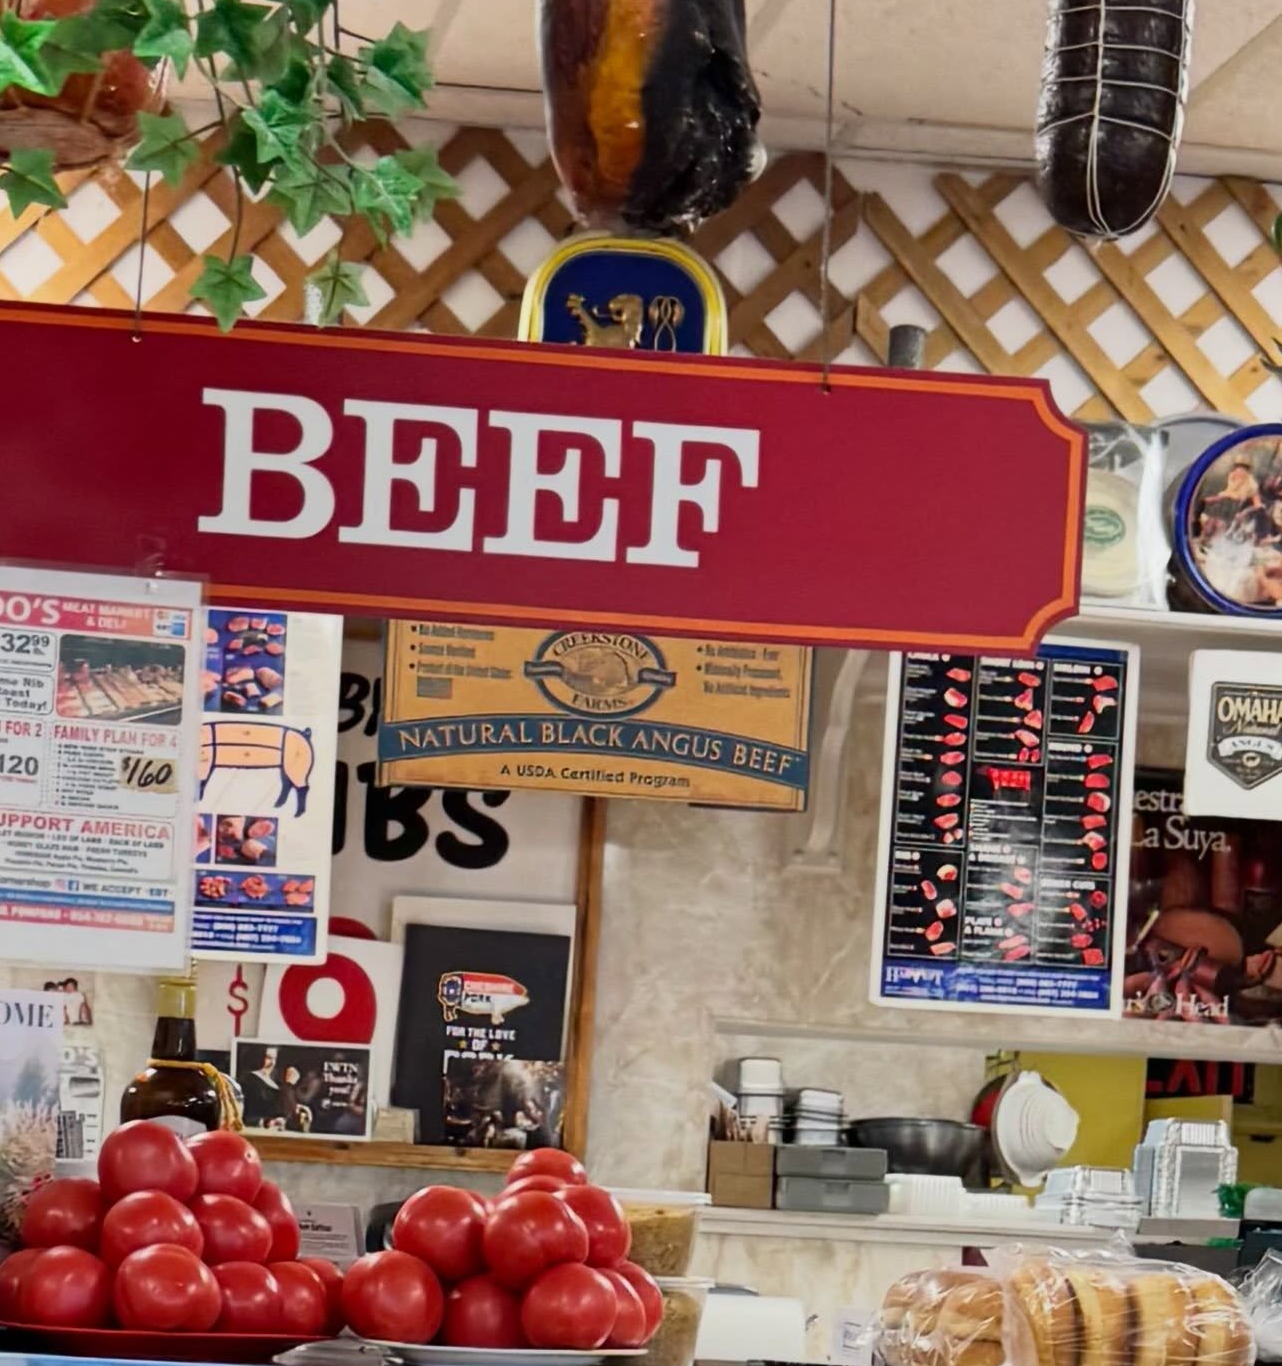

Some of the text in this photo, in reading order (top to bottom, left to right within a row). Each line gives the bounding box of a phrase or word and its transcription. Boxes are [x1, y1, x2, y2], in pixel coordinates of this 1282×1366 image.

[197, 388, 760, 568] BEEF
[572, 693, 625, 710] FARMS
[5, 720, 31, 736] FOR
[33, 723, 42, 737] 2
[54, 725, 100, 742] FAMILY
[398, 722, 793, 775] NATURAL BLACK ANGUS BEEF
[122, 756, 173, 788] $160
[500, 765, 690, 788] A USDA Certified Program
[81, 819, 170, 841] AMERICA
[1164, 815, 1232, 861] Suya.
[1175, 993, 1229, 1018] Head
[468, 1027, 487, 1039] THE
